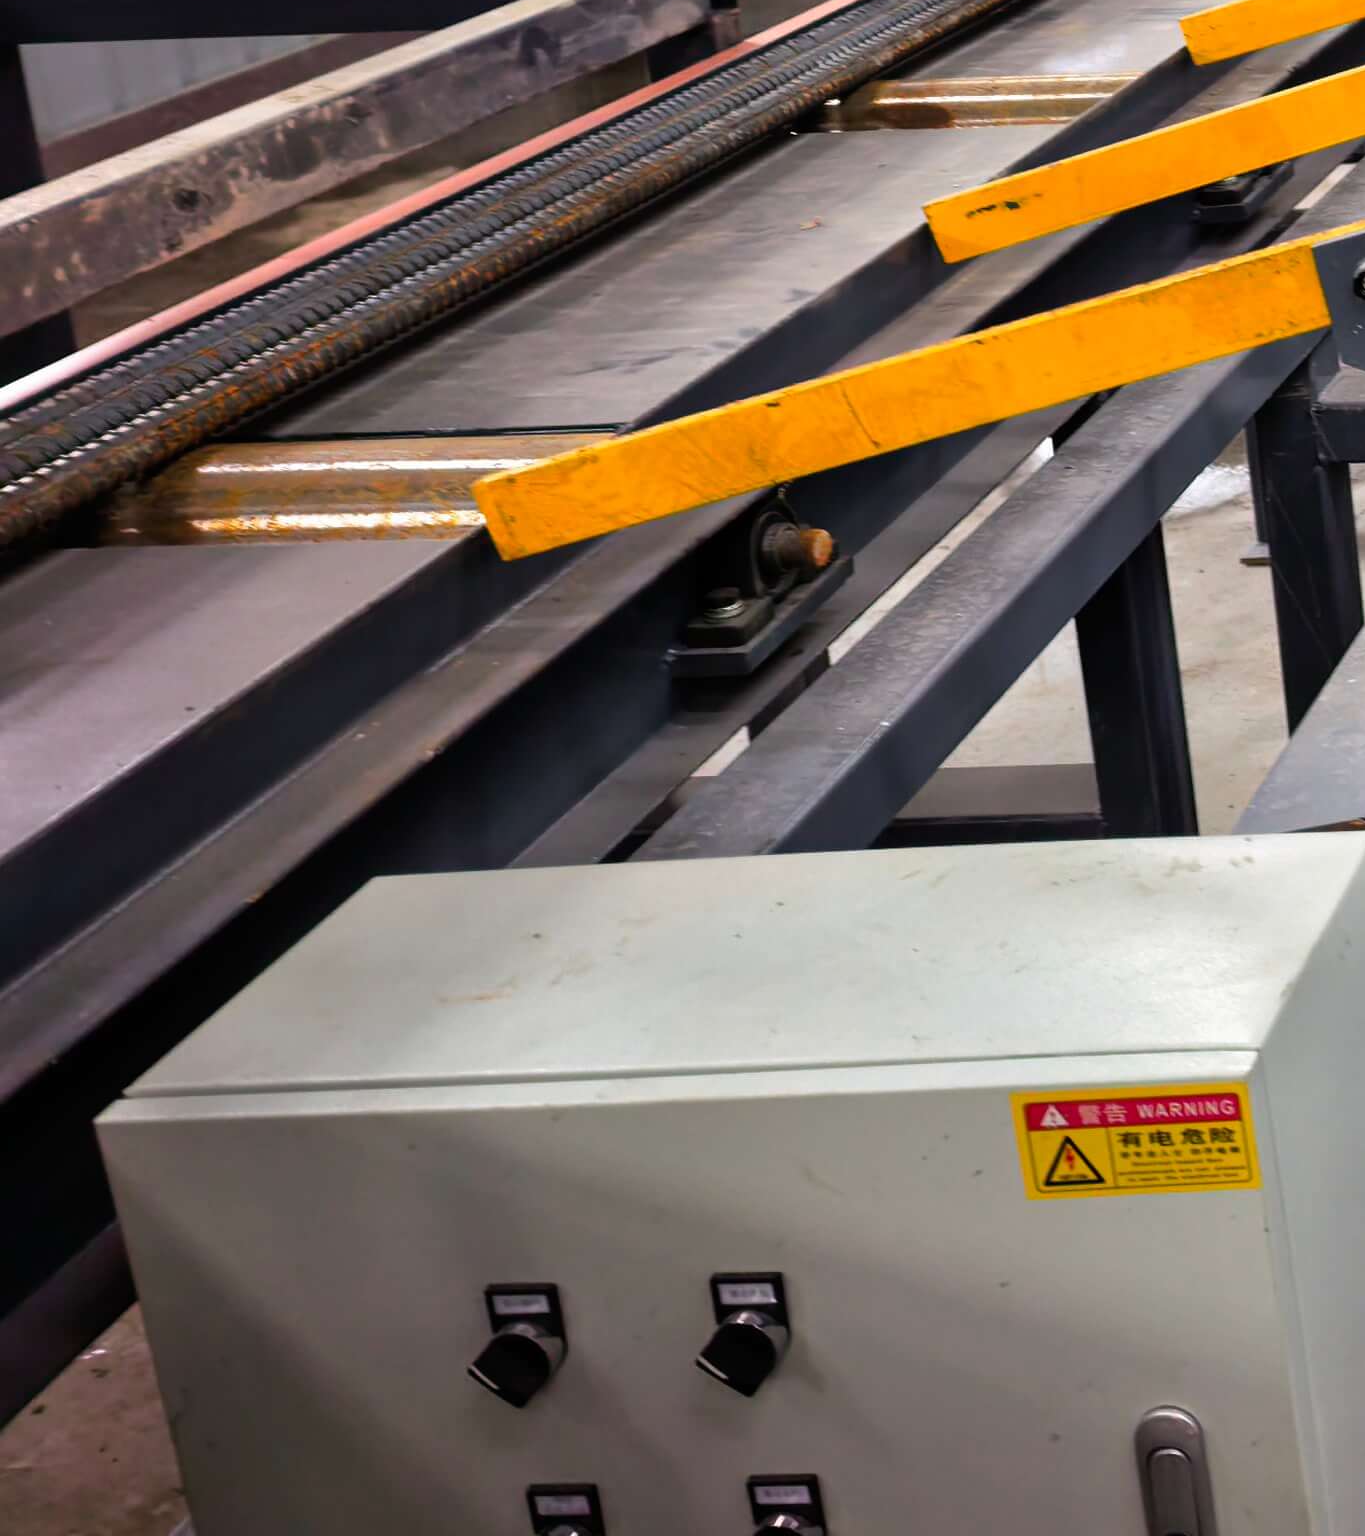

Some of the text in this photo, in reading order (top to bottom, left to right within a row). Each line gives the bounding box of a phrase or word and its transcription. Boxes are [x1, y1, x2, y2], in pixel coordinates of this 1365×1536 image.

[1078, 1099, 1236, 1125] 警告 WARNING
[1116, 1127, 1237, 1148] 有电危险
